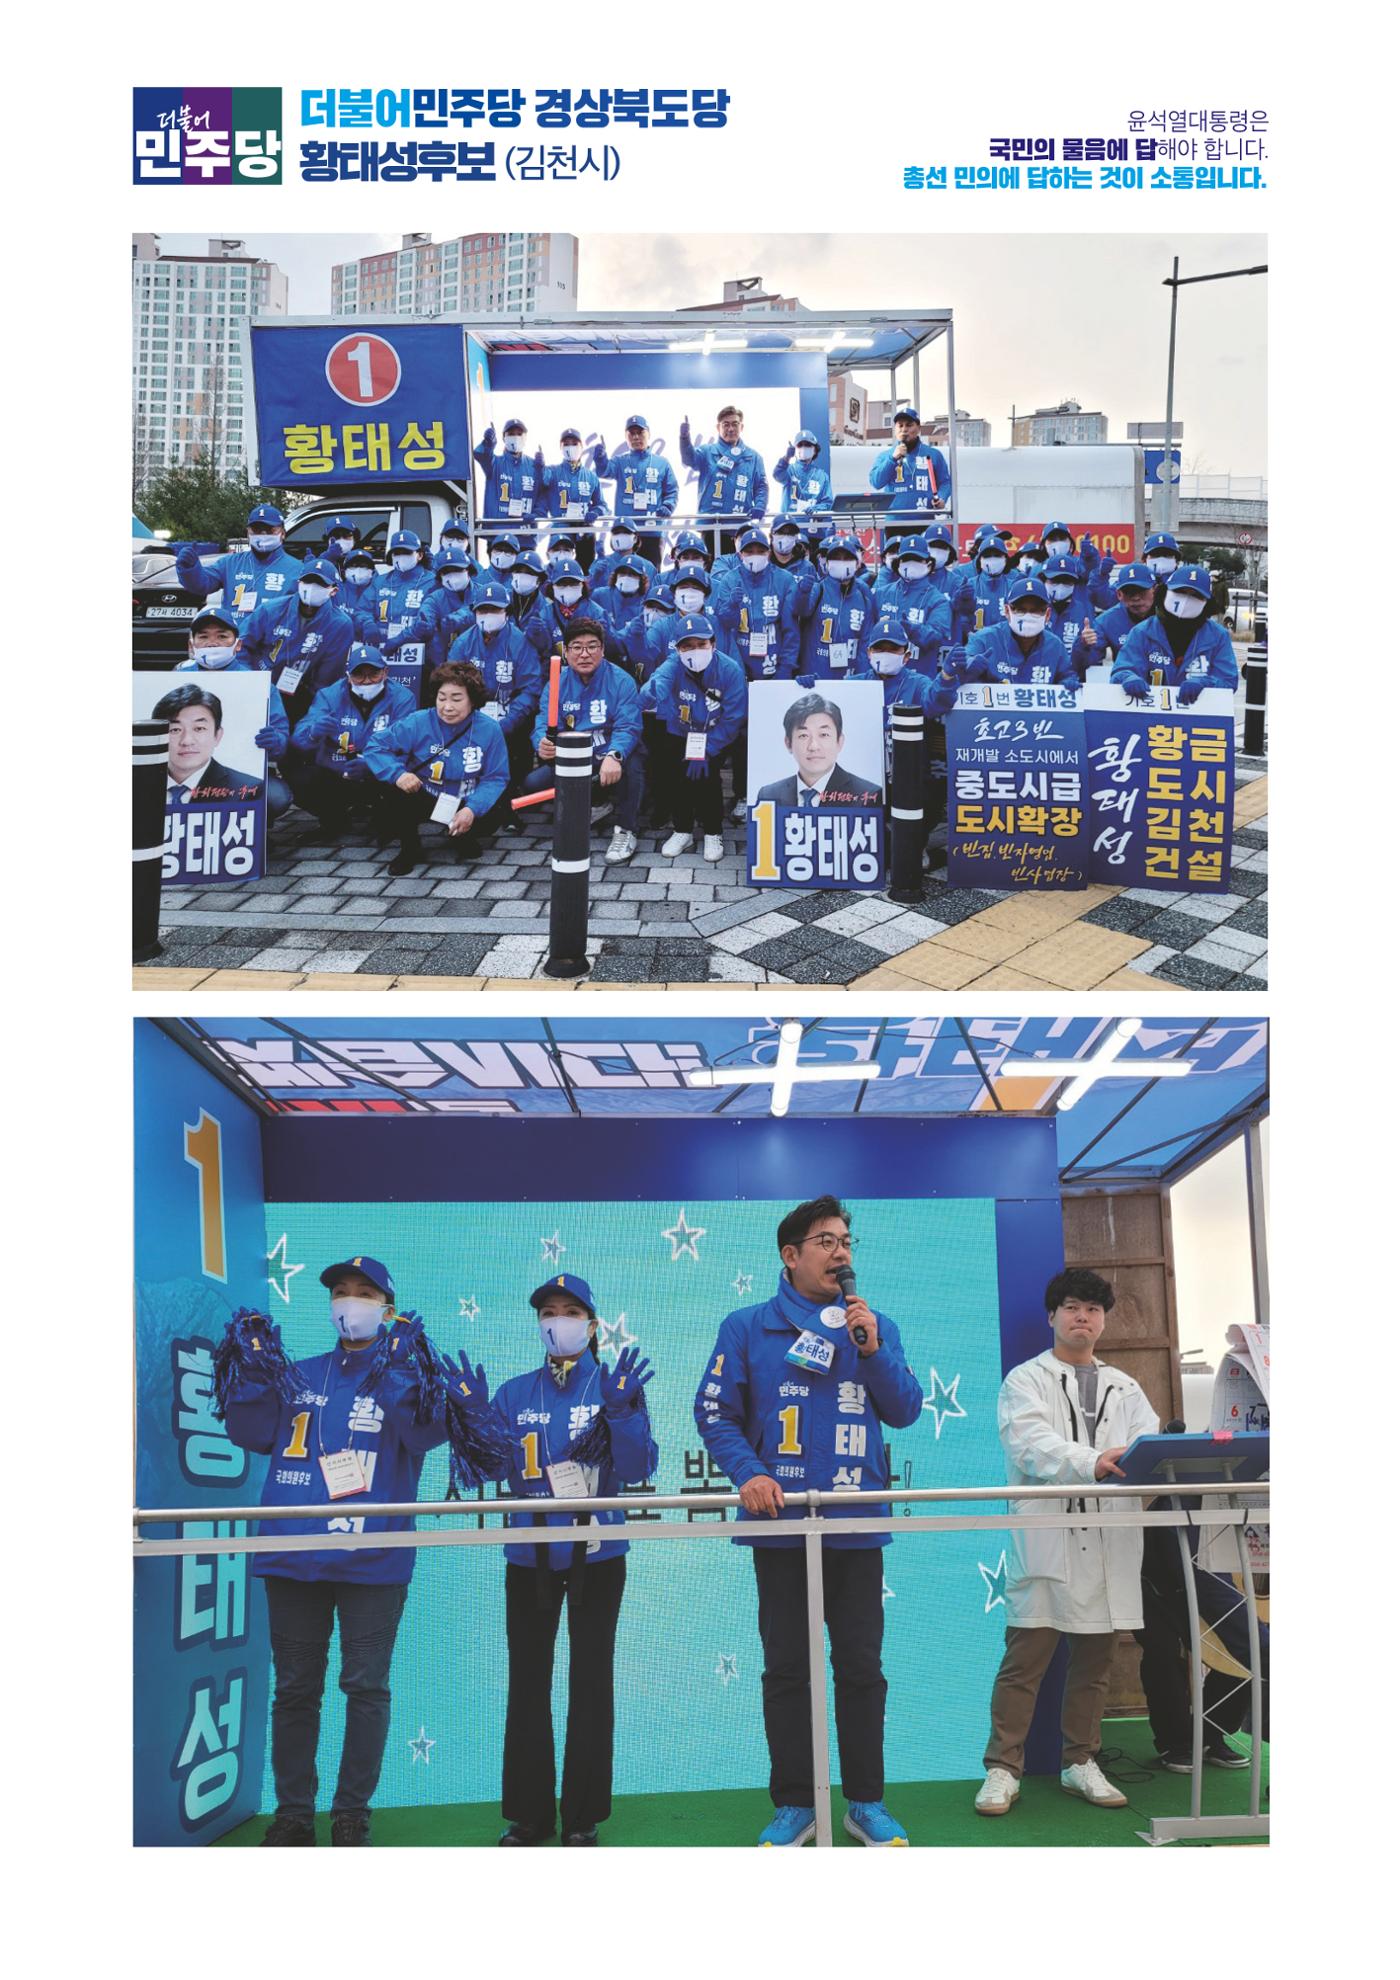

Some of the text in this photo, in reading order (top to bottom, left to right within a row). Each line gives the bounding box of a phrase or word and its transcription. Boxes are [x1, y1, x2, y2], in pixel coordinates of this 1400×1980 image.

[347, 341, 374, 398] 1
[283, 422, 446, 474] 황태성
[170, 608, 193, 617] 4034
[379, 600, 388, 622] 1
[820, 618, 833, 644] 1
[590, 699, 608, 724] 황
[982, 686, 994, 708] 1
[996, 691, 1010, 706] 번
[1014, 687, 1077, 709] 황태성
[1160, 688, 1173, 711] 1
[955, 748, 1079, 765] 재개발 소도시에서
[1147, 724, 1228, 763] 황금
[429, 761, 445, 785] 1
[462, 746, 484, 774] 황
[955, 770, 1082, 802] 중도시급
[1087, 733, 1143, 865] 황태성
[1146, 767, 1226, 804] 도시
[955, 804, 1083, 837] 도시확장
[1145, 806, 1225, 844] 김천
[751, 800, 879, 884] 1 황태성
[1144, 846, 1223, 882] 건설
[184, 1106, 228, 1285] 1
[251, 1337, 262, 1351] 1
[711, 1353, 724, 1376] 1
[460, 1381, 472, 1397] 1
[617, 1375, 627, 1390] 1
[779, 1384, 809, 1398] 민주당
[517, 1411, 551, 1426] 민주당
[1231, 1404, 1238, 1418] 6
[281, 1411, 312, 1458] 1
[778, 1405, 802, 1456] 1
[833, 1381, 868, 1491] 황태성
[520, 1431, 543, 1481] 1
